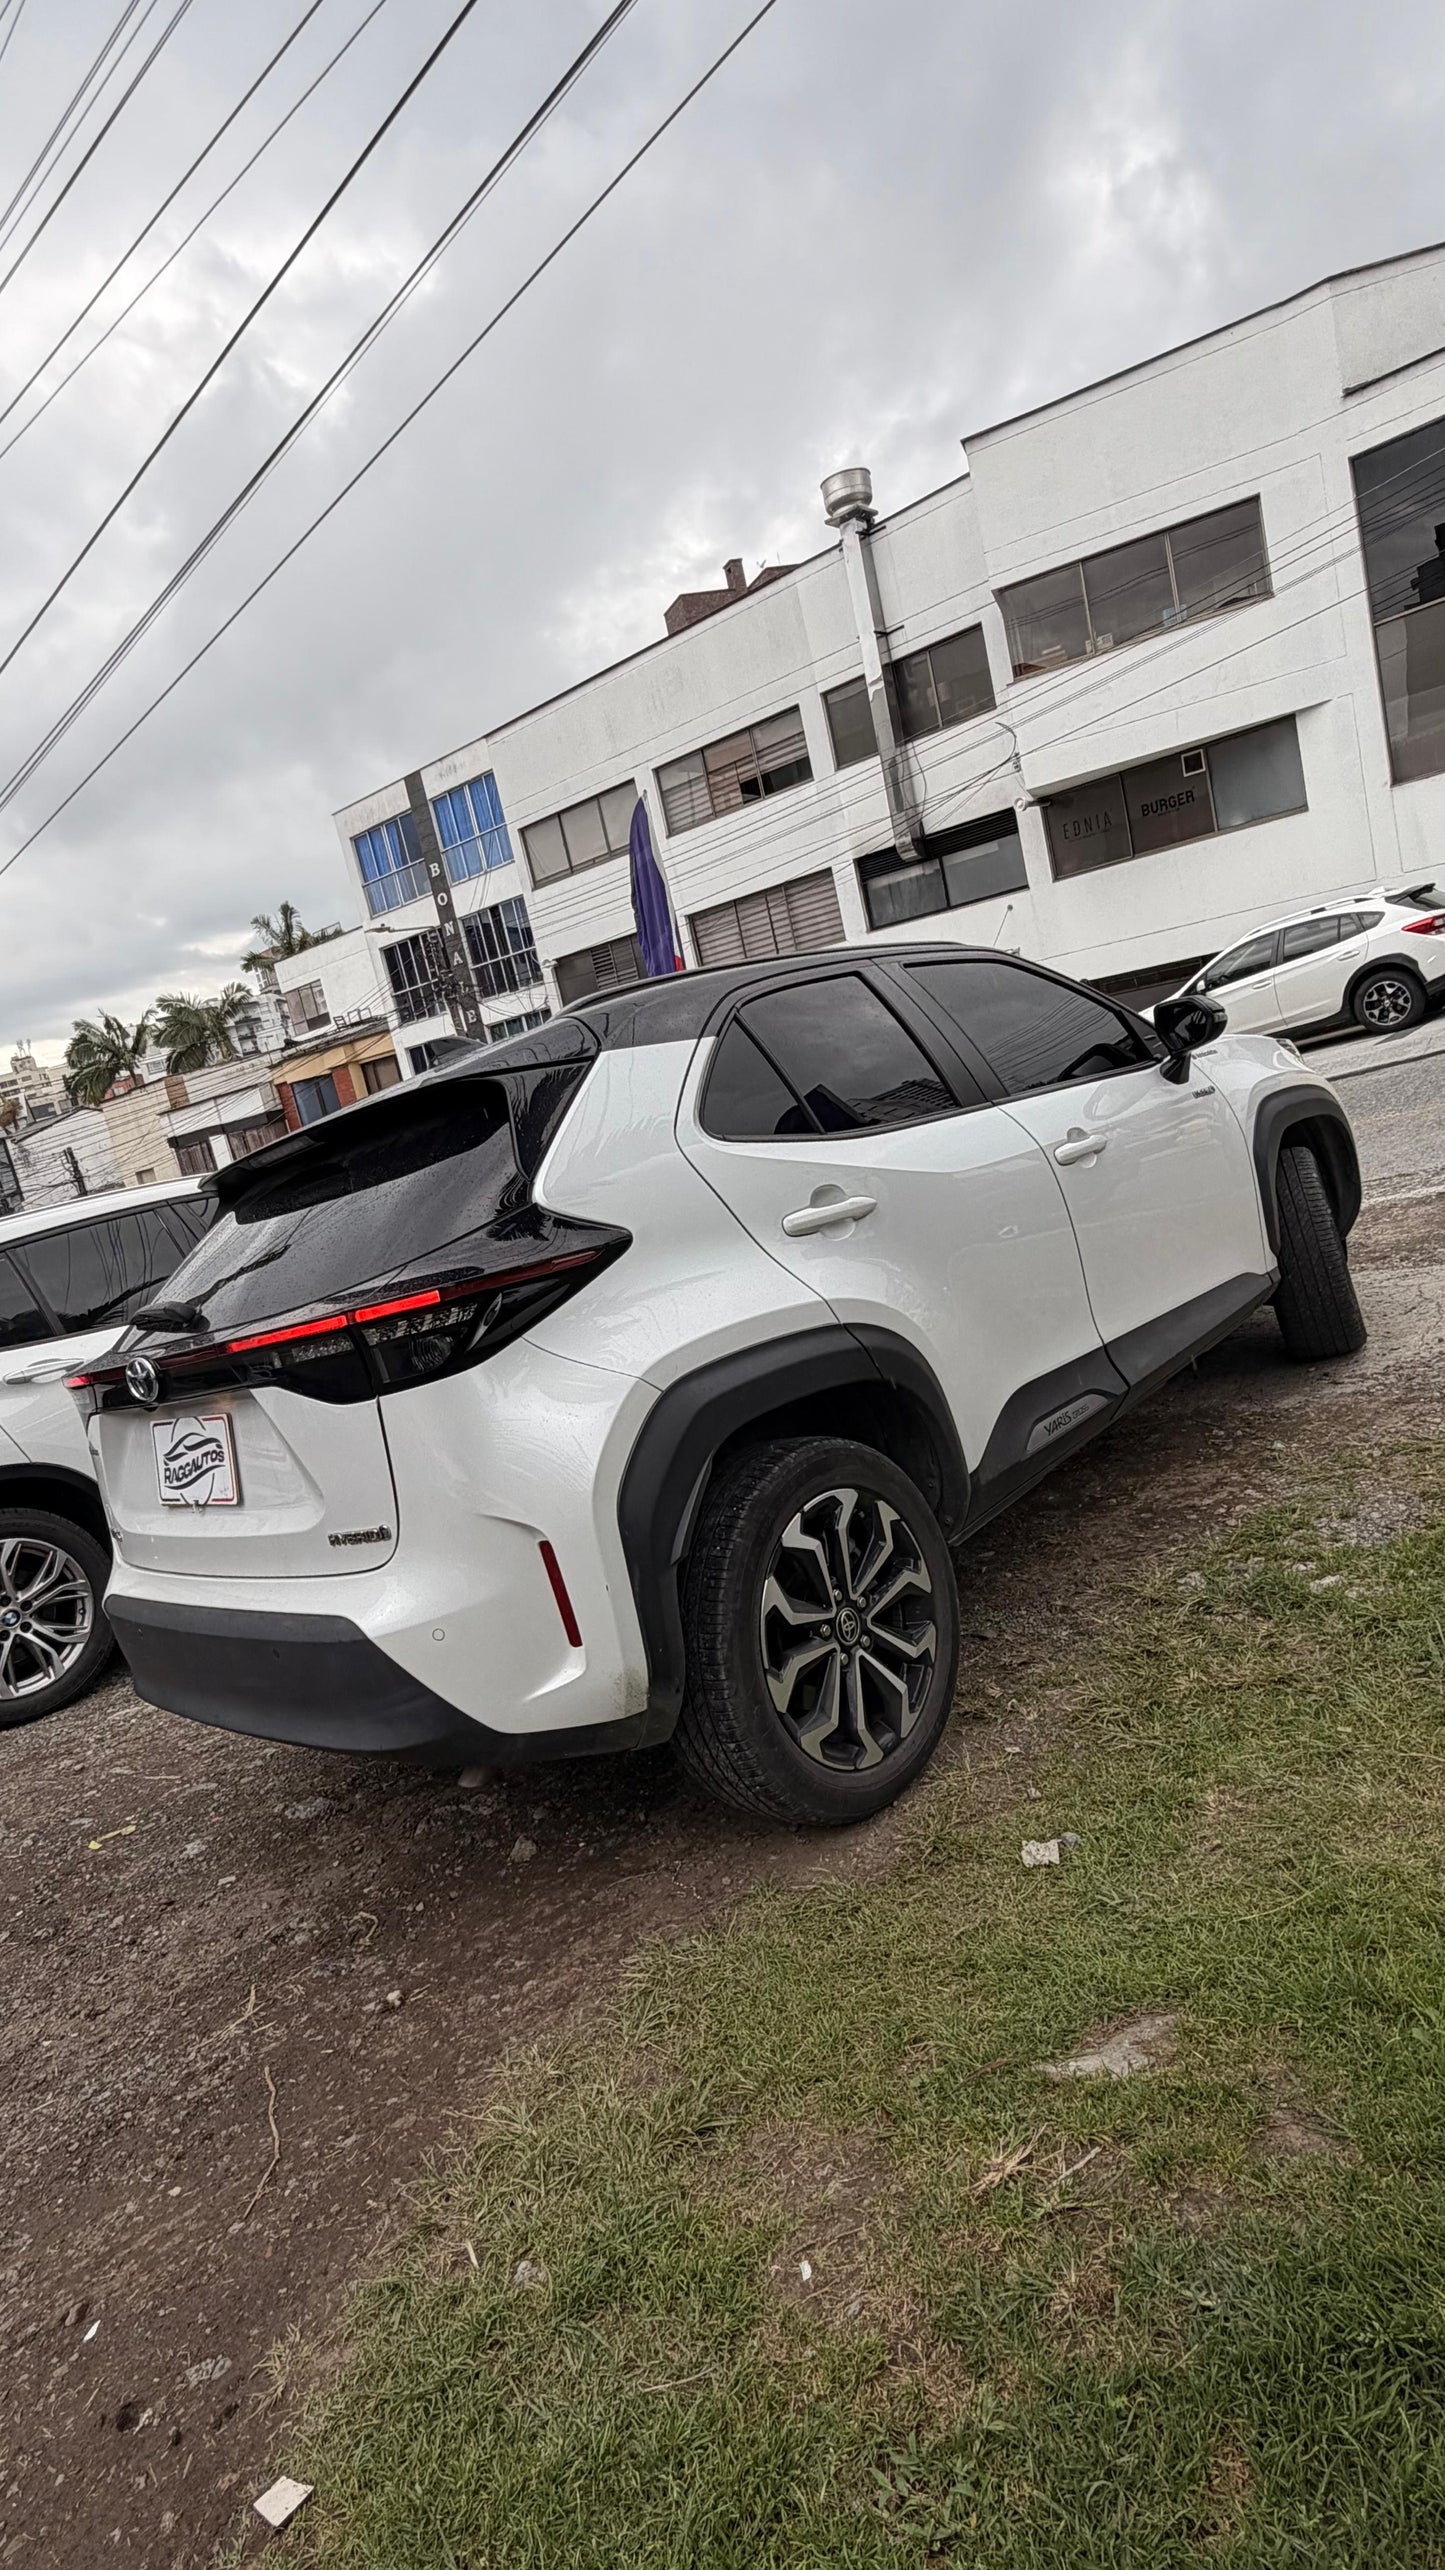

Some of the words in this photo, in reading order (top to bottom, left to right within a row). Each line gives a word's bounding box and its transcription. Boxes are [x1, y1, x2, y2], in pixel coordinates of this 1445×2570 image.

[1141, 789, 1196, 817] BURGER
[1062, 810, 1113, 840] EDNIA
[164, 1449, 225, 1484] RAGGAUTOS
